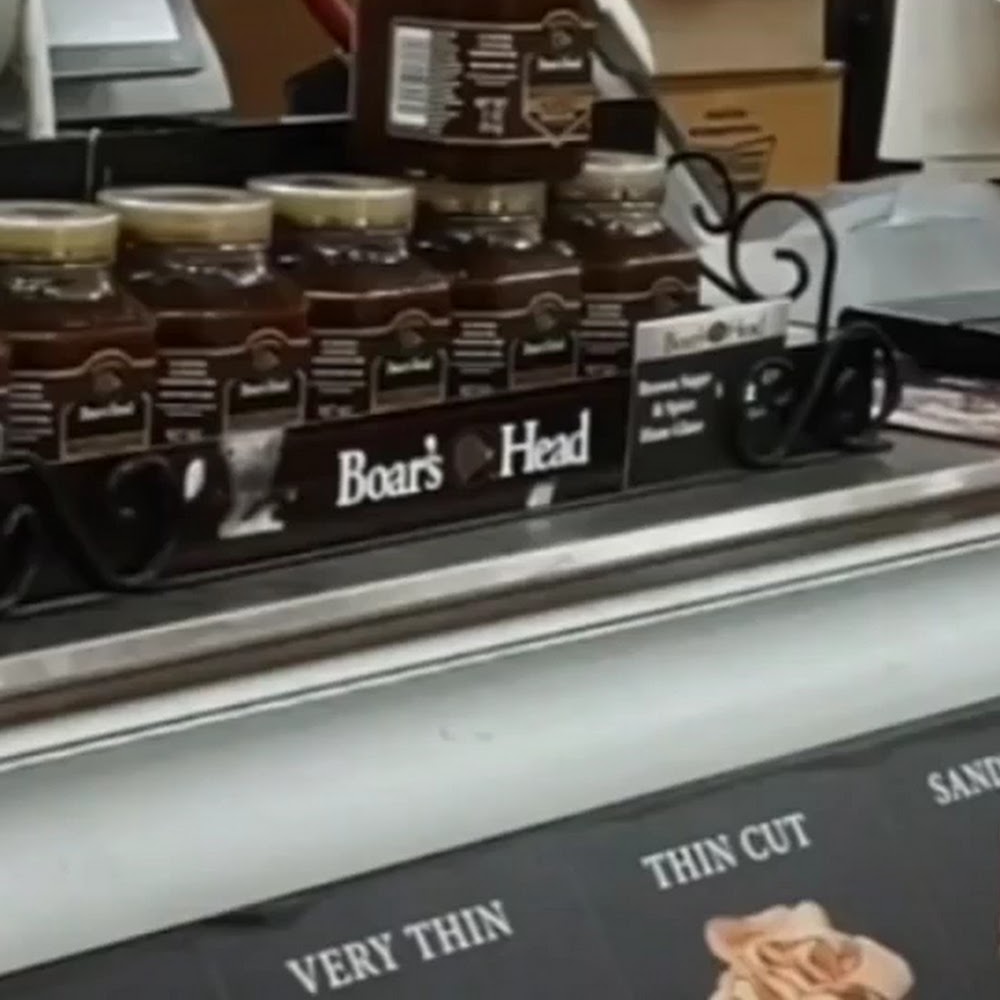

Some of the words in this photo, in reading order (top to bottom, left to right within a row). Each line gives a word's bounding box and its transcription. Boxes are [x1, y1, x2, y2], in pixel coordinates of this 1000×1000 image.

[336, 434, 443, 506] Boar's
[500, 408, 591, 478] Head
[640, 833, 739, 890] THIN
[740, 812, 812, 861] CUT
[284, 931, 401, 996] VERY
[402, 899, 514, 962] THIN
